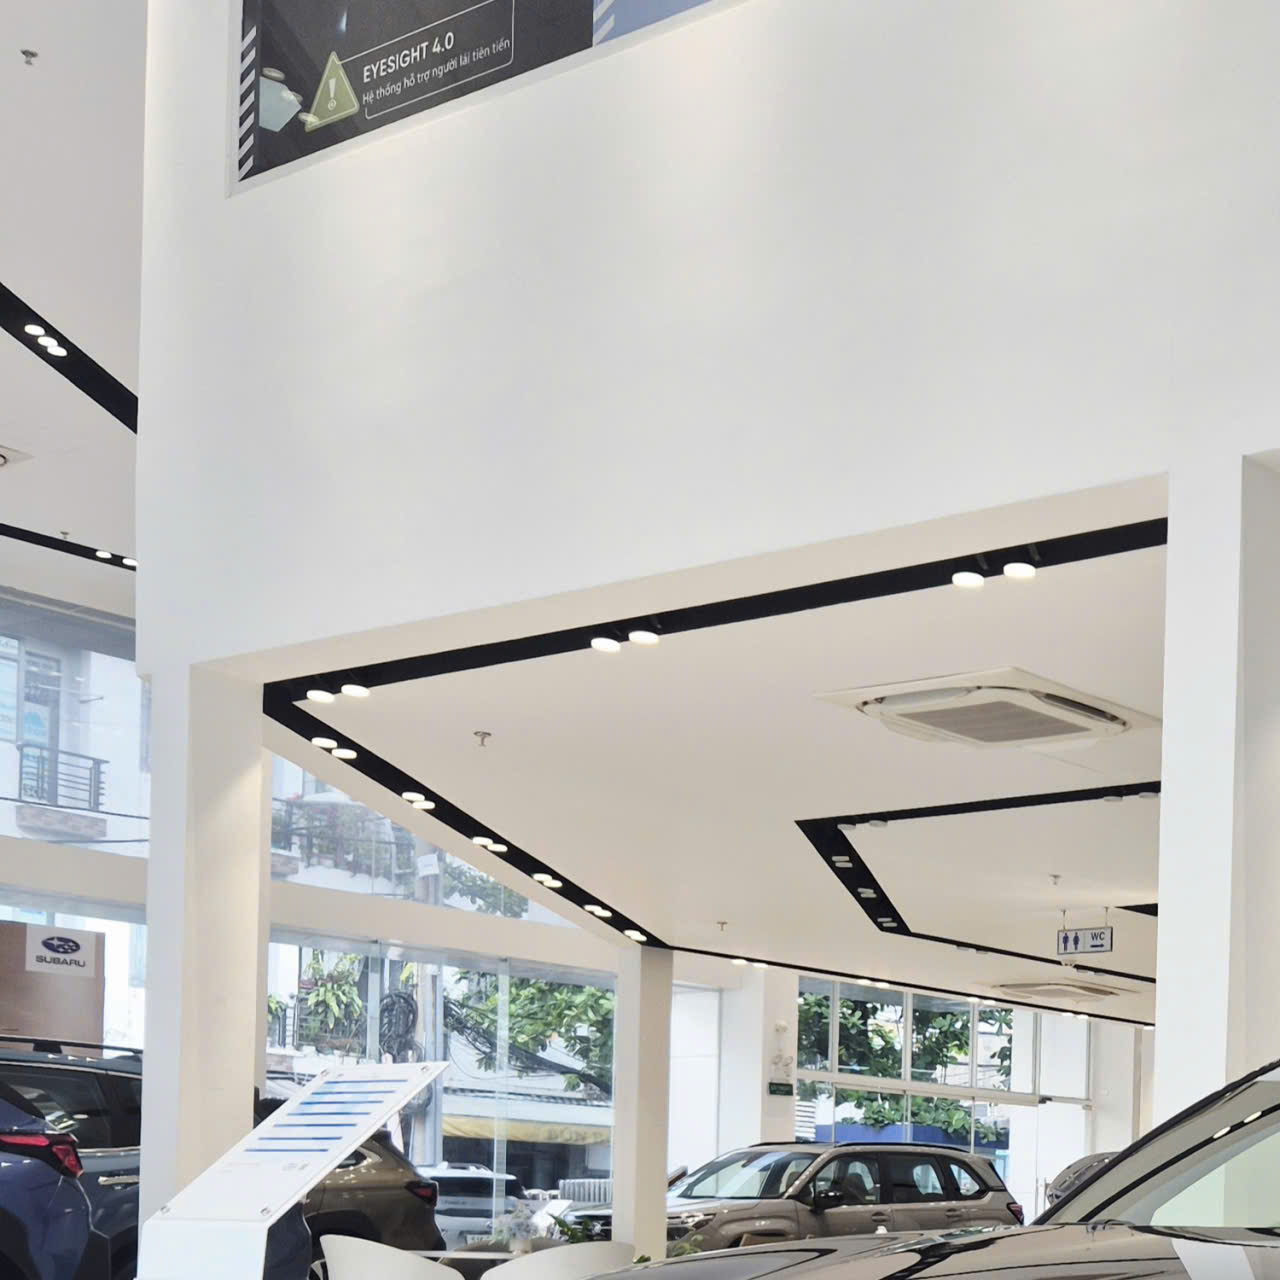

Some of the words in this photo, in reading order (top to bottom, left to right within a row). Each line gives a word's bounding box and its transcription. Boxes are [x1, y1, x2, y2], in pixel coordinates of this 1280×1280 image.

[362, 92, 374, 105] Hệ
[376, 81, 401, 99] thống
[403, 74, 416, 89] hỗ
[417, 70, 431, 84] trợ
[432, 58, 458, 79] người
[460, 54, 471, 67] lái
[472, 46, 490, 62] tiên
[492, 37, 510, 54] tiến
[363, 41, 429, 83] EYESIGHT
[432, 32, 454, 54] 4.0
[1090, 931, 1106, 941] WC
[35, 955, 86, 968] SUBARU
